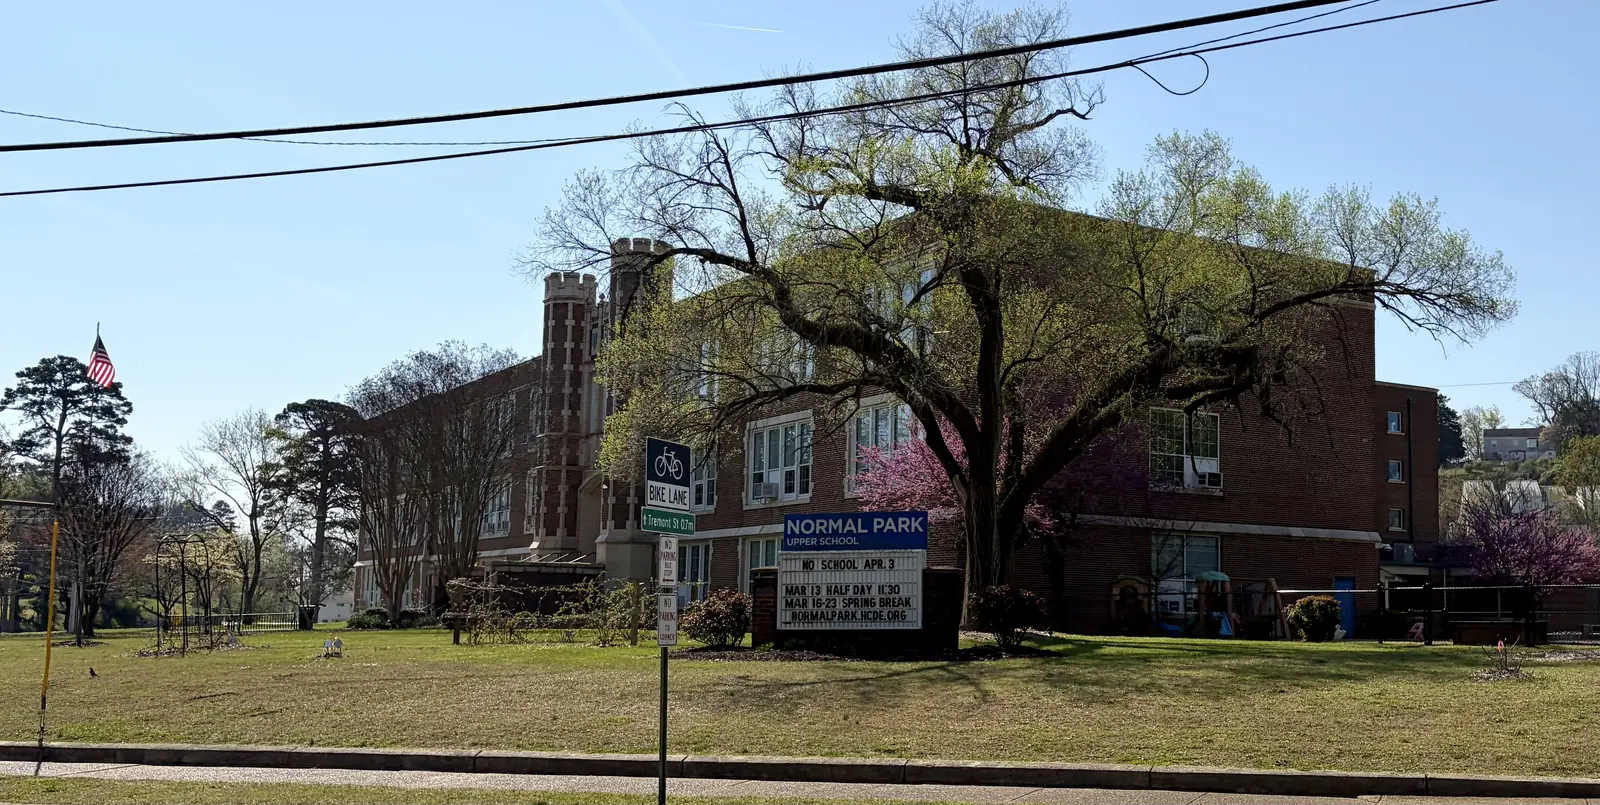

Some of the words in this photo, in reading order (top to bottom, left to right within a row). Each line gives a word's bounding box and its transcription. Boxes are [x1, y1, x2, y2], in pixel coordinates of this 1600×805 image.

[650, 485, 666, 502] BIKE
[669, 488, 687, 505] LANE
[648, 514, 671, 528] Tremont
[673, 517, 679, 529] St
[787, 518, 868, 534] NORMAL
[873, 517, 924, 533] PARK
[664, 540, 672, 550] NO
[787, 537, 817, 546] UPPER
[820, 536, 859, 546] SCHOOL
[660, 551, 676, 561] PARKING
[802, 560, 814, 570] NO
[821, 559, 858, 570] SCHOOL
[864, 559, 886, 569] APR.
[888, 559, 895, 569] 3
[785, 585, 806, 596] MAR
[811, 585, 821, 595] 13
[826, 585, 850, 595] HALF
[853, 585, 872, 595] DAY
[664, 598, 671, 608] NO
[785, 598, 807, 608] MAR
[812, 598, 837, 608] 16-23
[842, 598, 876, 608] SPRING
[879, 597, 911, 608] BREAK
[660, 612, 676, 621] PARKING
[791, 610, 907, 621] NORMALPARK.HCDE.ORG
